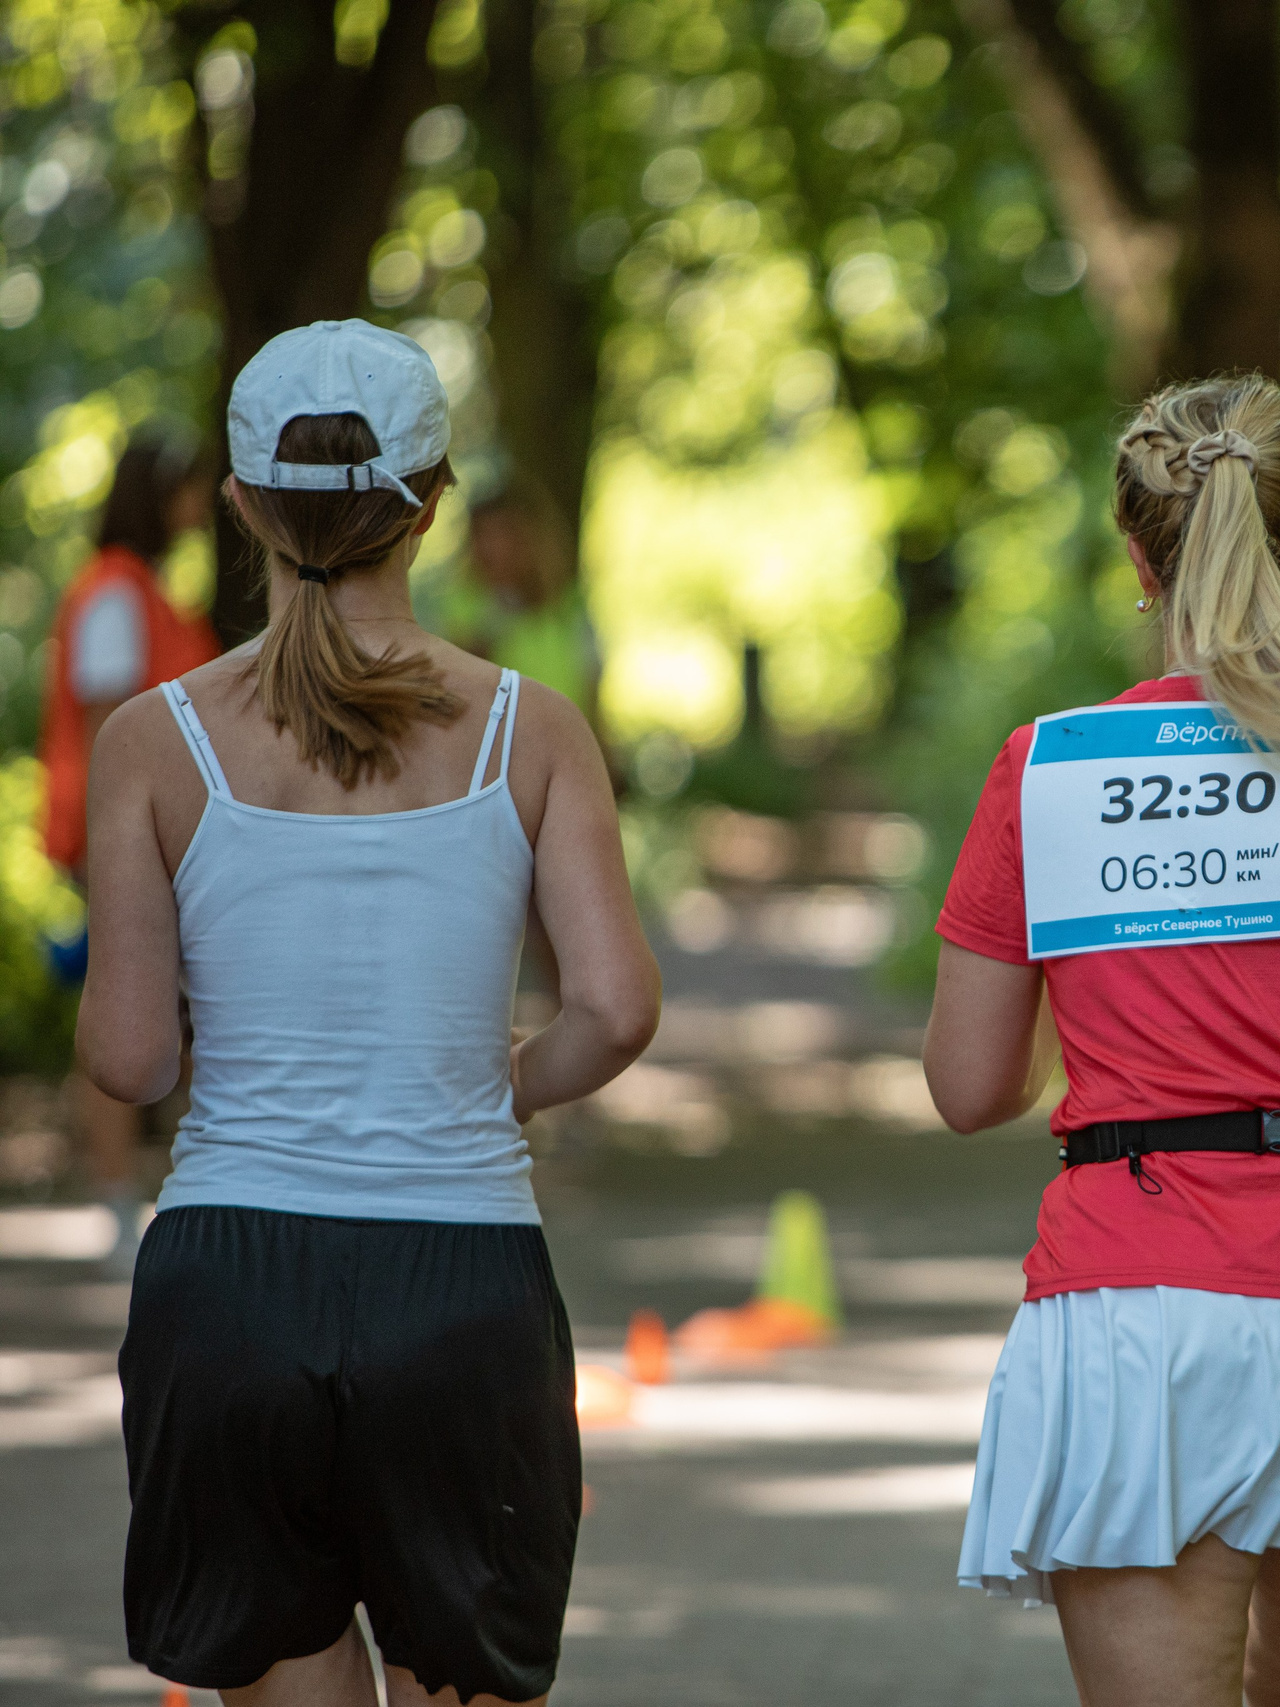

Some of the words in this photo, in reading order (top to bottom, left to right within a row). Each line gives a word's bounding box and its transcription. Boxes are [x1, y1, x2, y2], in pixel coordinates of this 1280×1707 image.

[1101, 771, 1276, 824] 32:30
[1101, 848, 1227, 892] 06:30
[1236, 842, 1279, 861] мин/
[1236, 869, 1261, 882] км
[1114, 923, 1122, 935] 5
[1124, 922, 1159, 935] вёрст
[1161, 919, 1222, 931] Северное
[1224, 914, 1273, 928] Тушино
